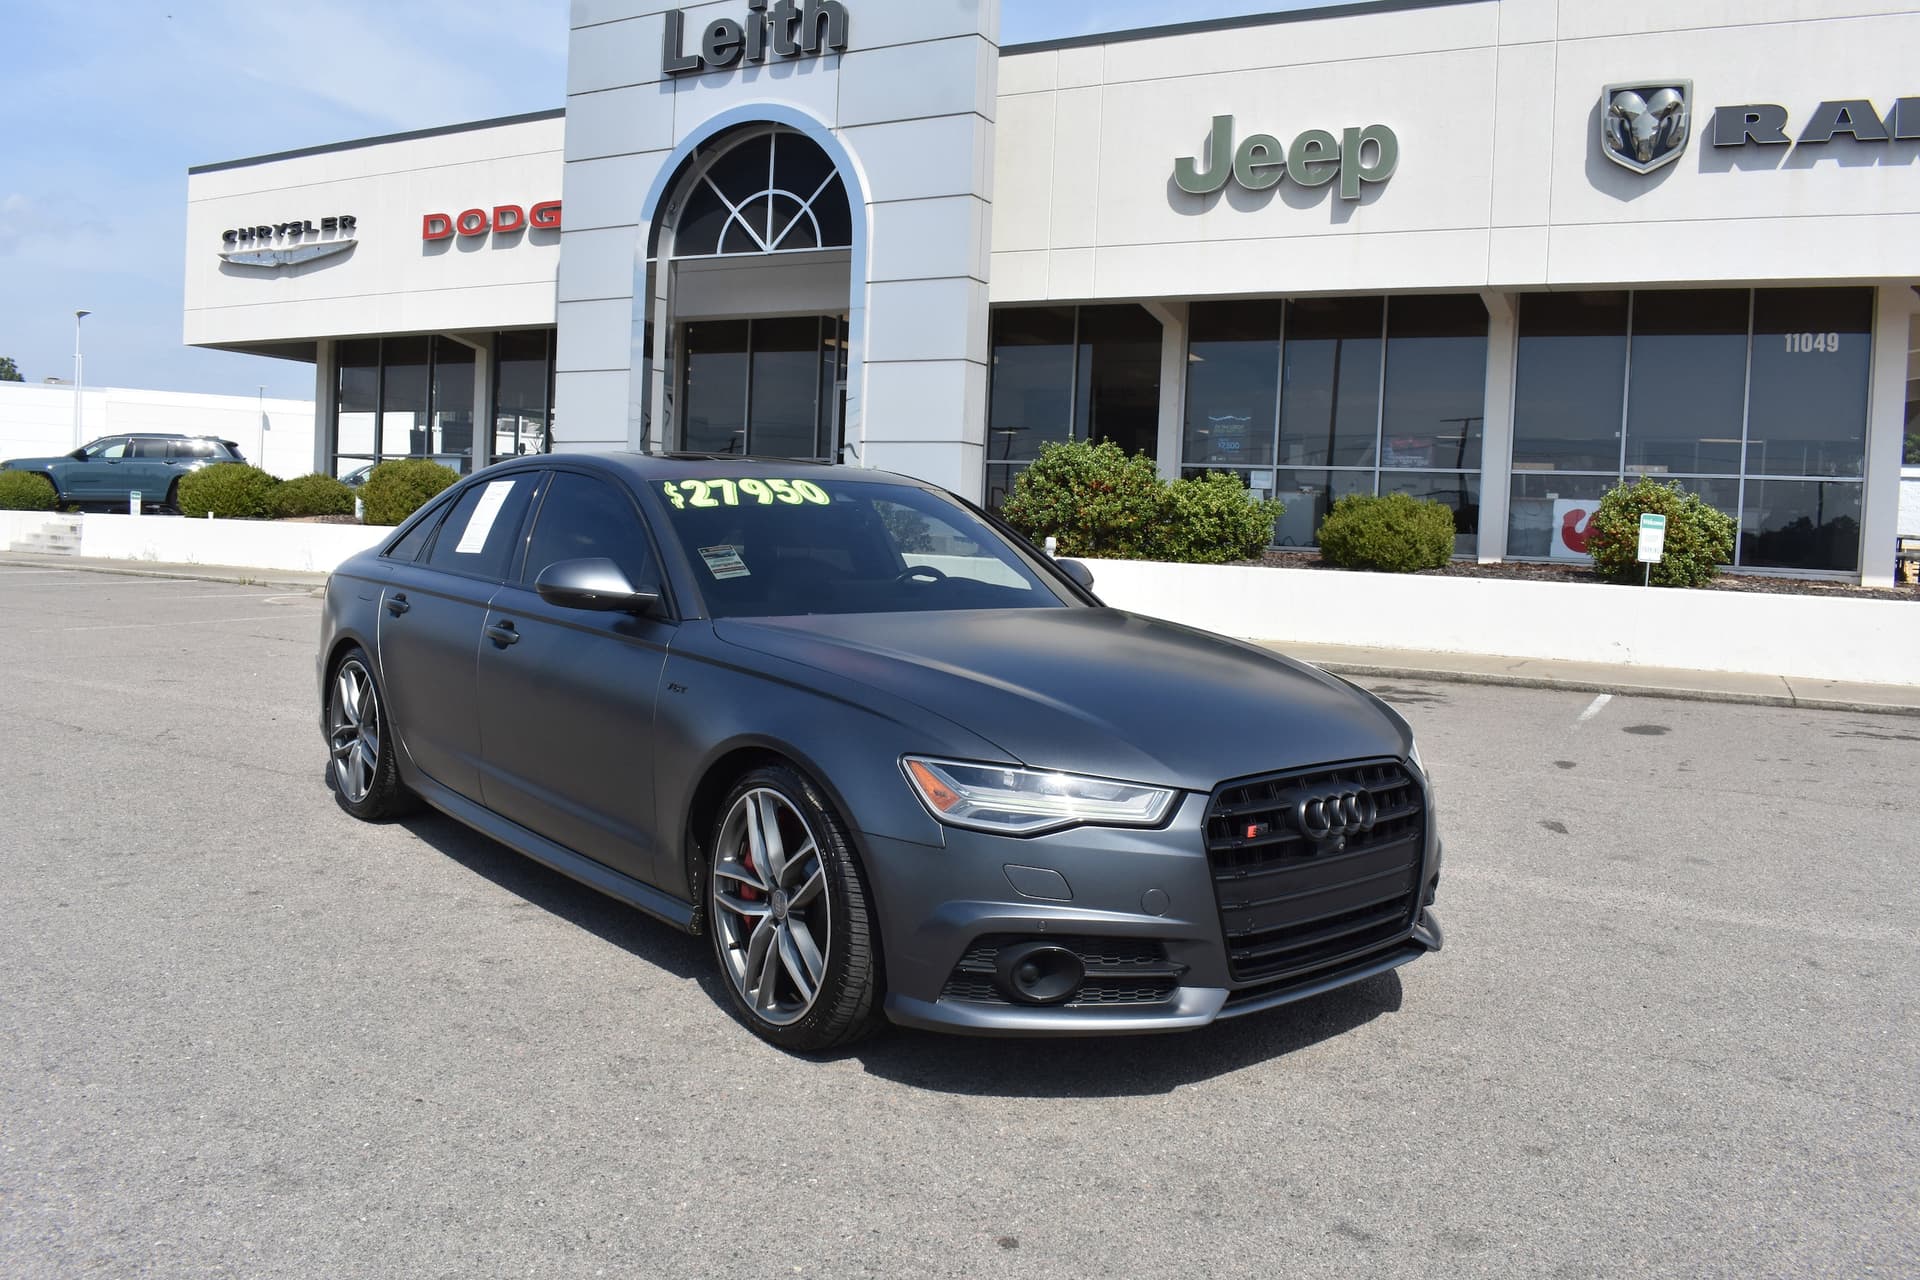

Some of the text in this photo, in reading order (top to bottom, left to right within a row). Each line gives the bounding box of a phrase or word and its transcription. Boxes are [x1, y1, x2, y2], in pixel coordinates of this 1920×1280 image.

[663, 0, 849, 74] Leith
[1713, 97, 1920, 146] RA
[1174, 114, 1399, 199] Jeep
[222, 215, 357, 243] CHRYSLER
[1784, 333, 1839, 352] 11049
[664, 479, 830, 509] $27950
